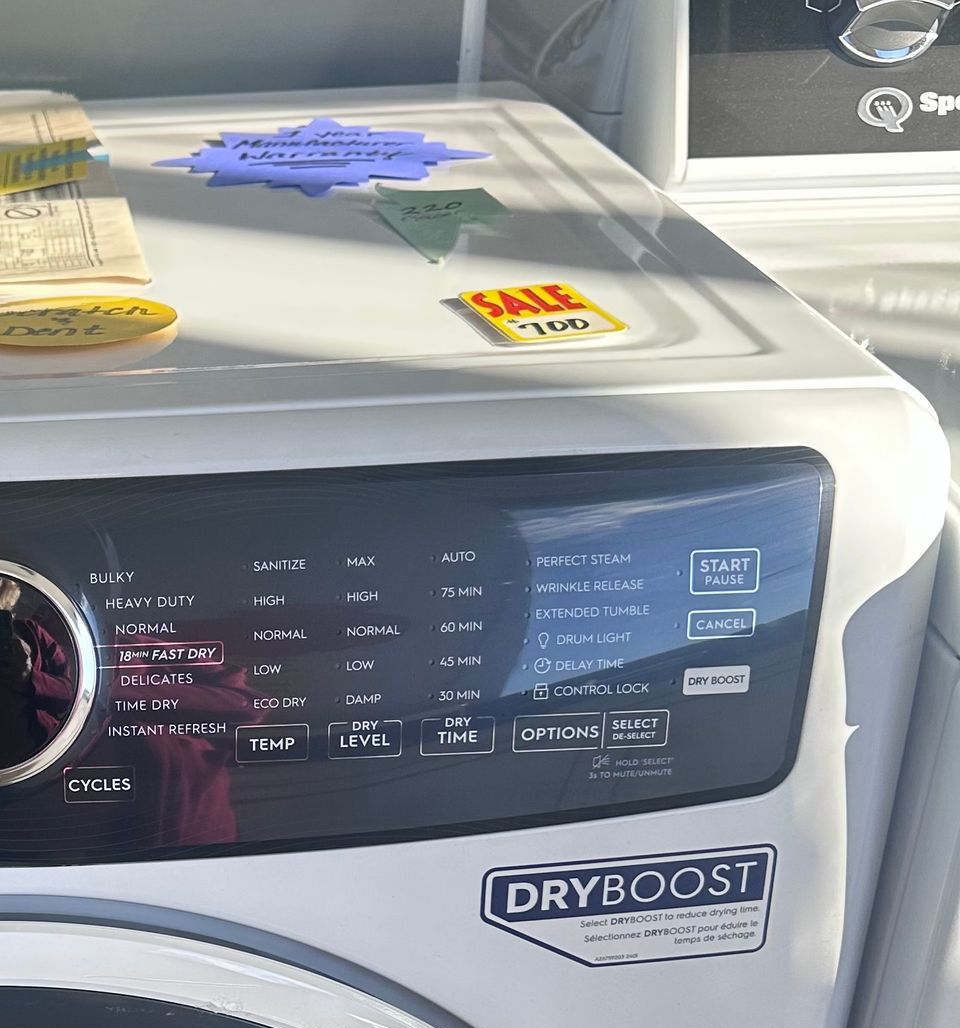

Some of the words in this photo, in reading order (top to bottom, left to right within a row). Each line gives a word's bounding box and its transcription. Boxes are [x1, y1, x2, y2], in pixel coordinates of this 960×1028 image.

[470, 284, 588, 318] SALE
[0, 324, 107, 338] Dent
[347, 556, 376, 567] MAX
[441, 551, 476, 563] AUTO
[536, 555, 587, 567] PERFECT
[591, 553, 631, 565] STEAM
[253, 559, 307, 572] SANITIZE
[700, 557, 751, 573] START
[90, 571, 135, 584] BULKY
[705, 574, 744, 585] PAUSE
[440, 587, 456, 598] 75
[458, 586, 483, 597] MIN
[536, 582, 591, 594] WRINKLE
[594, 579, 645, 591] RELEASE
[105, 597, 152, 610] HEAVY
[157, 595, 195, 608] DUTY
[253, 595, 285, 606] HIGH
[347, 591, 379, 602] HIGH
[535, 607, 600, 620] EXTENDED
[603, 605, 650, 617] TUMBLE
[115, 622, 177, 635] NORMAL
[347, 625, 401, 637] NORMAL
[440, 622, 456, 633] 60
[458, 621, 483, 632] MIN
[696, 618, 746, 631] CANCEL
[253, 629, 308, 641] NORMAL
[556, 633, 593, 645] DRUM
[597, 632, 632, 643] LIGHT
[151, 648, 185, 660] FAST
[187, 647, 217, 660] DRY
[346, 660, 375, 671] LOW
[439, 656, 455, 667] 45
[457, 655, 482, 666] MIN
[555, 659, 594, 672] DELAY
[597, 658, 625, 669] TIME
[253, 664, 282, 675] LOW
[121, 673, 193, 687] DELICATES
[688, 675, 709, 686] DRY
[711, 674, 746, 685] BOOST
[438, 690, 454, 701] 30
[456, 690, 481, 701] MIN
[554, 684, 614, 697] CONTROL
[617, 683, 650, 694] LOCK
[115, 700, 147, 711] TIME
[151, 699, 179, 711] DRY
[253, 698, 280, 709] ECO
[282, 697, 307, 708] DRY
[345, 694, 382, 705] DAMP
[352, 720, 379, 731] DRY
[445, 717, 472, 728] DRY
[612, 718, 658, 730] SELECT
[108, 725, 164, 737] INSTANT
[169, 723, 227, 735] REFRESH
[521, 725, 599, 741] OPTIONS
[612, 731, 656, 740] DE-SELECT
[340, 733, 390, 748] LEVEL
[437, 730, 478, 744] TIME
[249, 737, 295, 751] TEMP
[615, 759, 639, 767] HOLD
[613, 768, 673, 778] MUTE/UNMUTE
[68, 778, 131, 792] CYCLES
[506, 861, 758, 914] DRYBOOST
[580, 918, 608, 928] Select
[611, 913, 663, 926] DRYBOOST
[665, 913, 674, 921] to
[676, 910, 707, 920] reduce
[709, 907, 737, 917] drying
[584, 931, 641, 943] Sélectionnez
[644, 925, 696, 938] DRYBOOST
[697, 924, 719, 934] pour
[674, 936, 701, 945] temps
[703, 934, 715, 942] de
